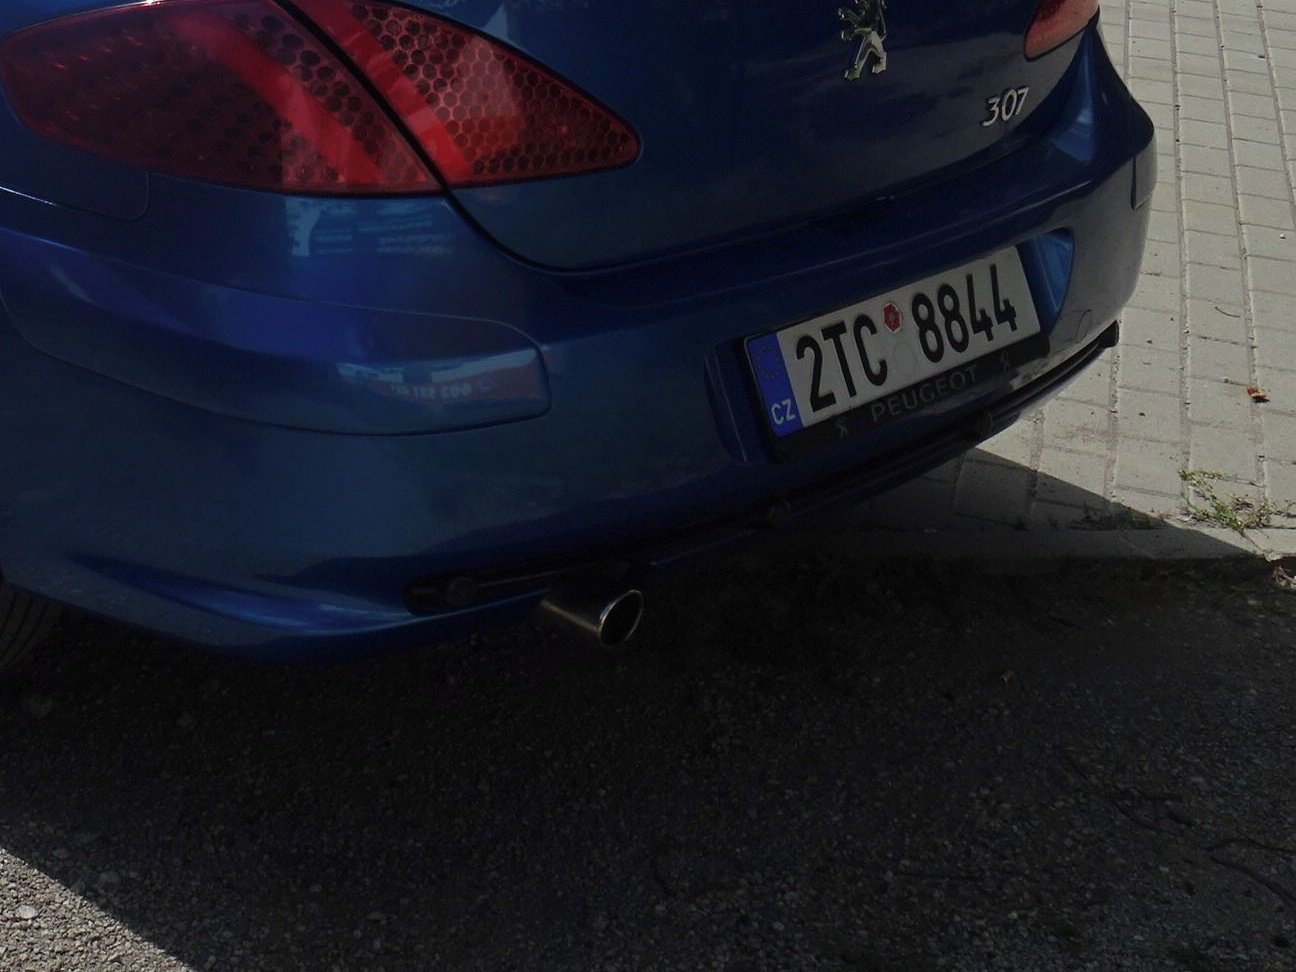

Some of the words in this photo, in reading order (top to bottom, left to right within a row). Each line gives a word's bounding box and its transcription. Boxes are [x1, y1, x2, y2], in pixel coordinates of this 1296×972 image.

[982, 86, 1030, 127] 307
[796, 313, 888, 413] 2TC
[911, 264, 1017, 364] 8844
[770, 399, 796, 426] CZ
[871, 366, 977, 423] PEUGEOT
